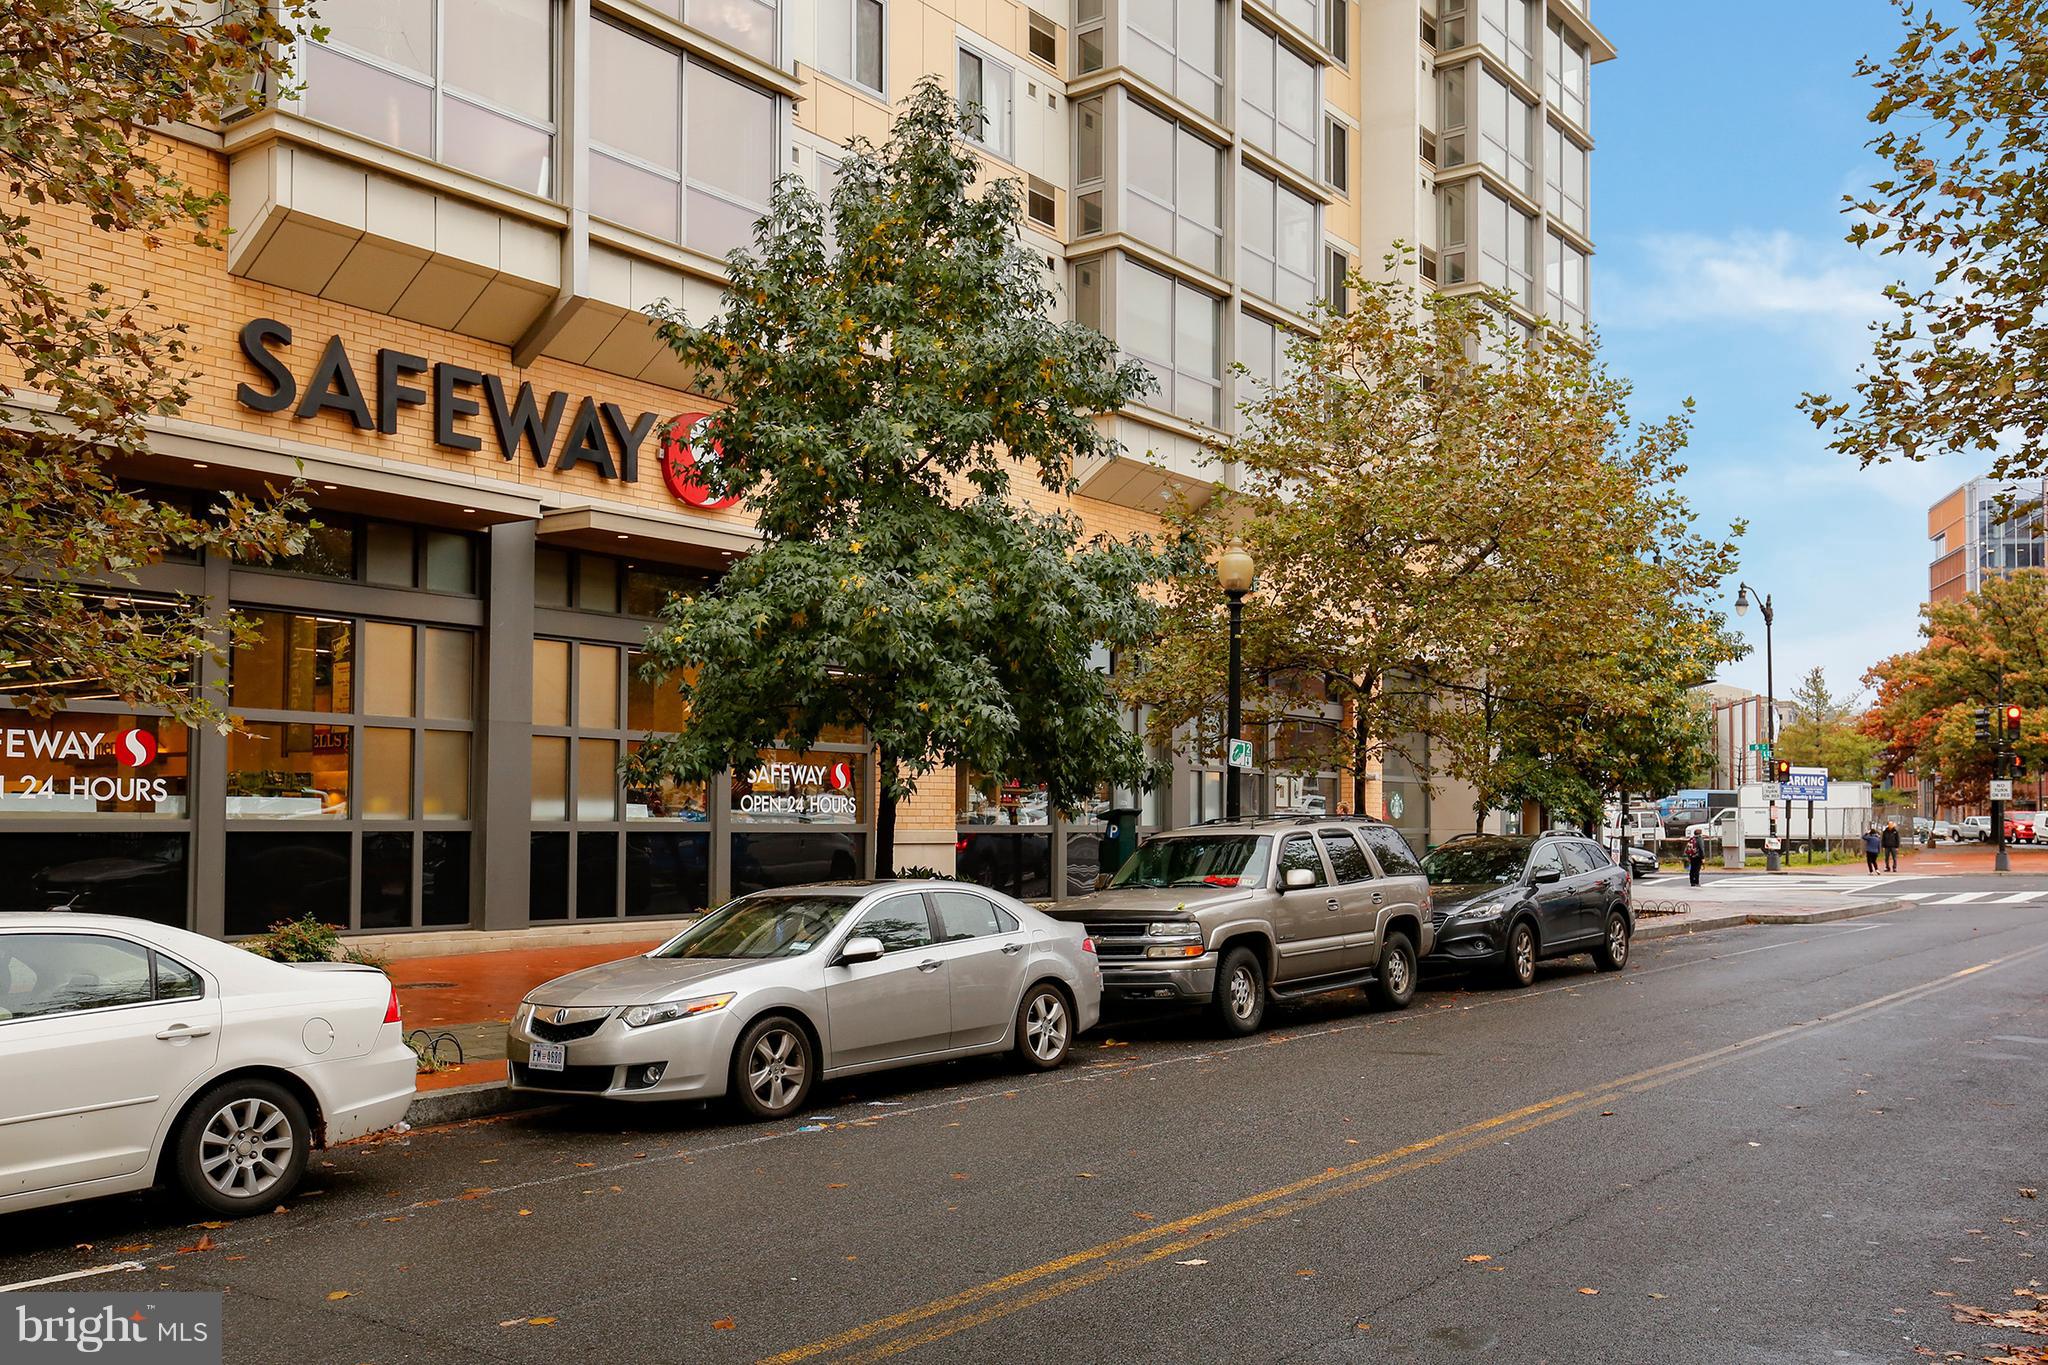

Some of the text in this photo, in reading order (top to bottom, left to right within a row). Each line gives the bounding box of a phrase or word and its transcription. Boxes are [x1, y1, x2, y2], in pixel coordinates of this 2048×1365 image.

[237, 317, 659, 483] SAFEWAY
[747, 764, 826, 785] SAFEWAY
[1786, 776, 1824, 787] ARKING
[19, 775, 55, 800] 24
[69, 777, 168, 802] HOURS
[740, 795, 857, 814] OPEN 24 HOURS
[1110, 825, 1118, 838] P
